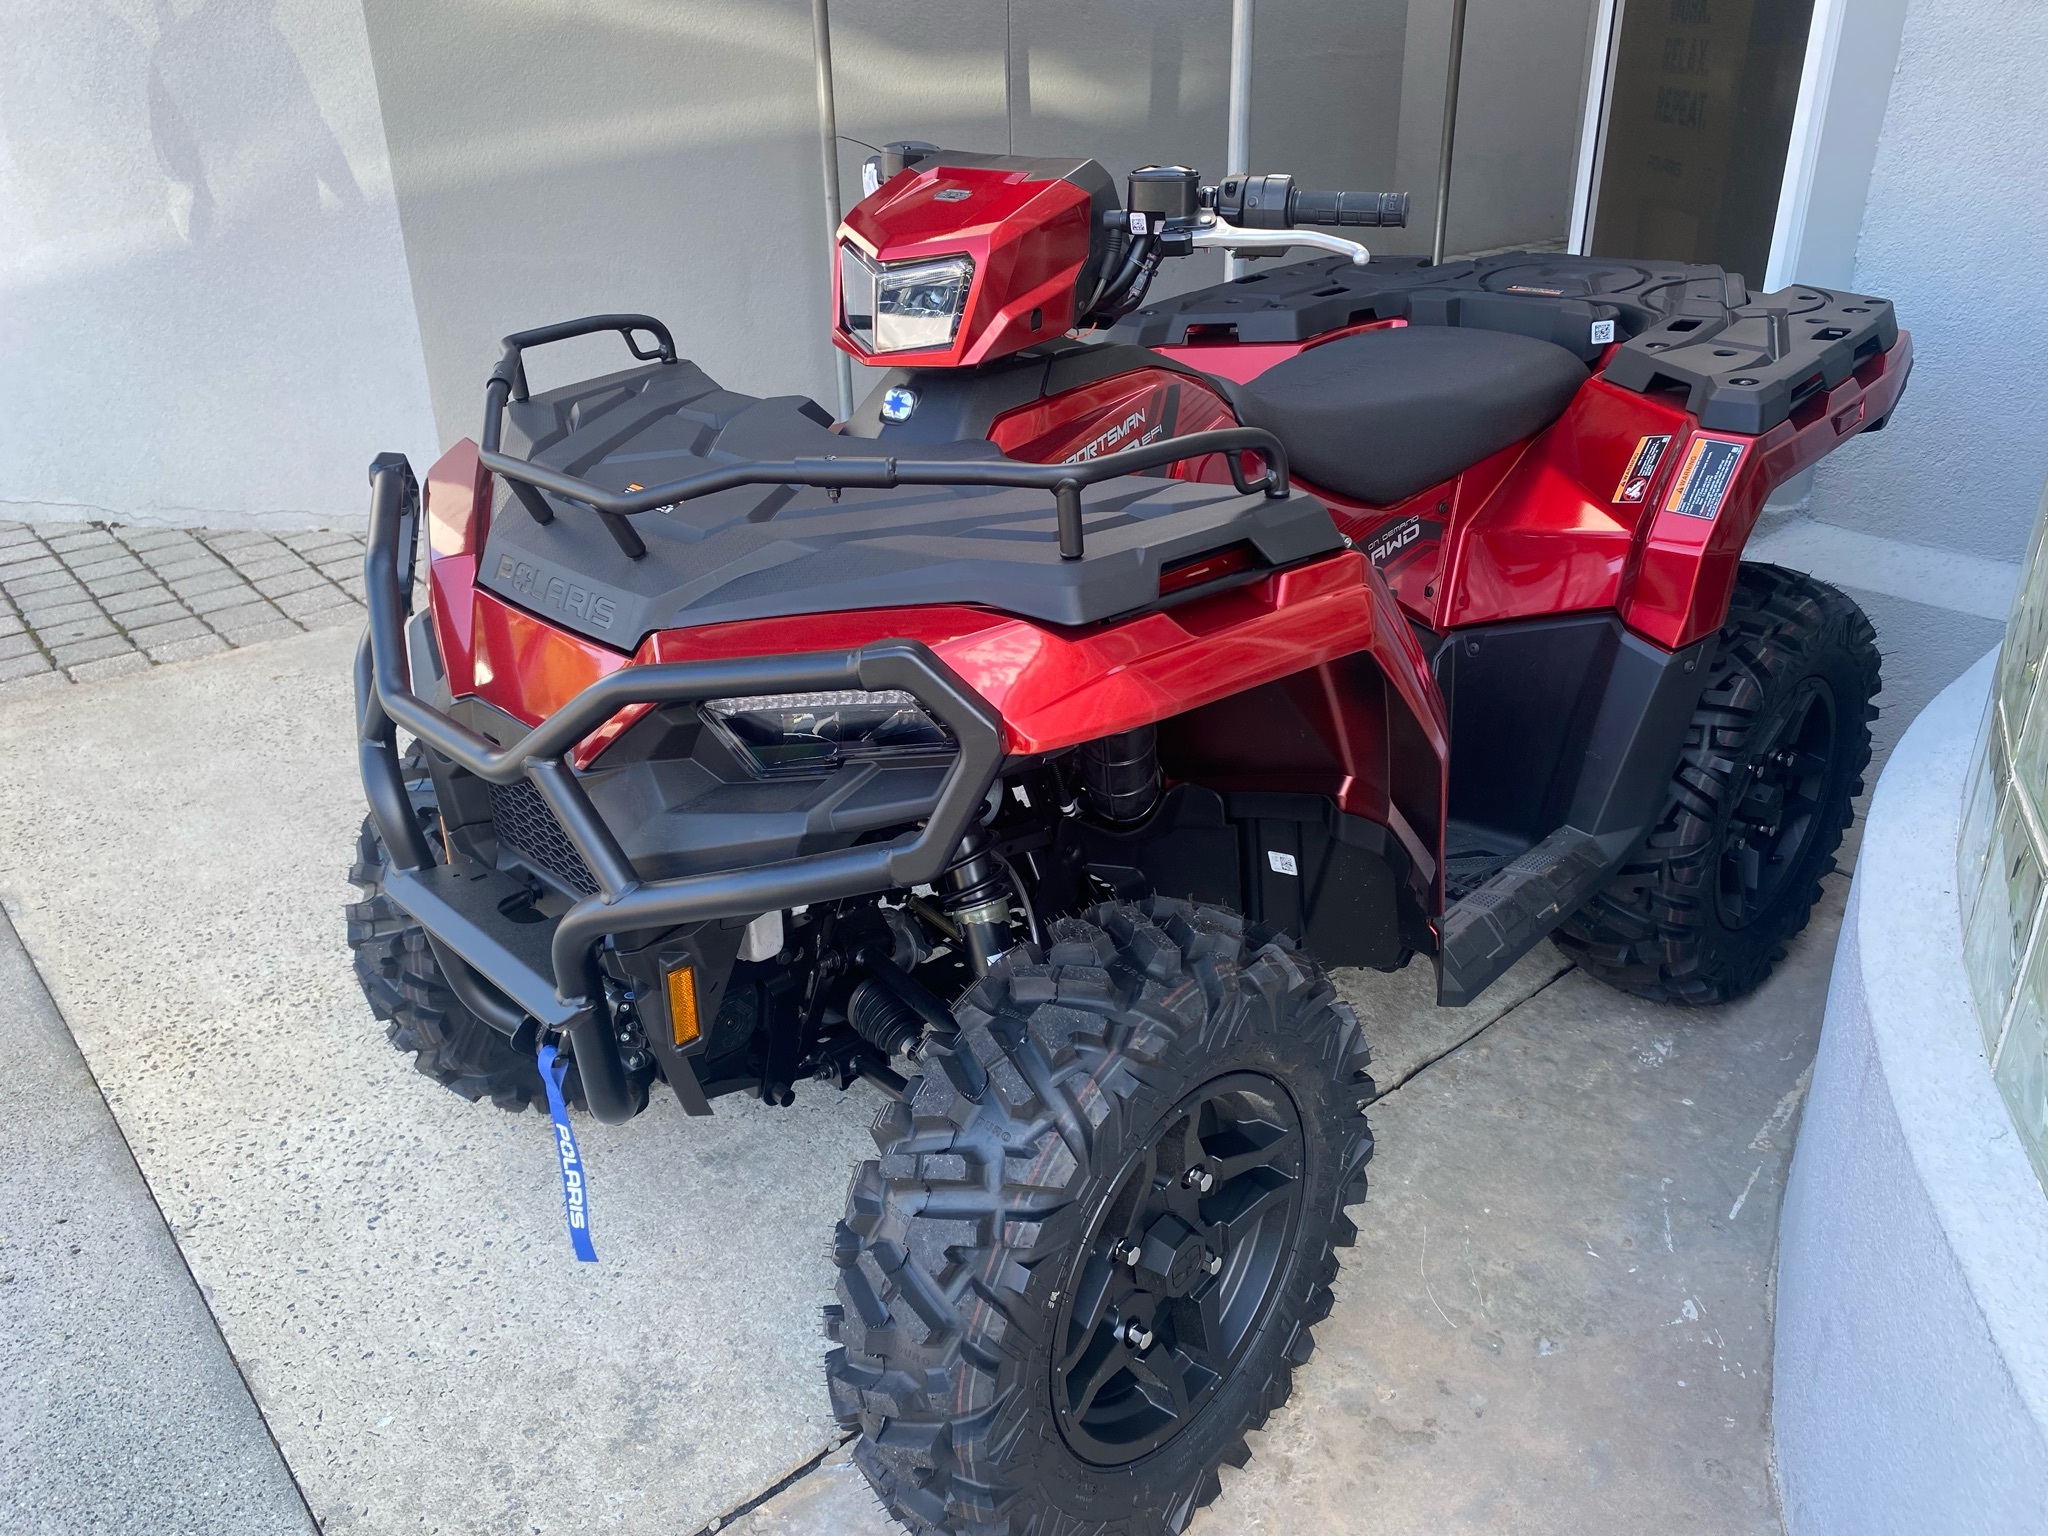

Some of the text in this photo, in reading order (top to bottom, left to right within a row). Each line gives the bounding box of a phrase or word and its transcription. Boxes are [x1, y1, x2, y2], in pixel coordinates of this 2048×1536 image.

[1061, 407, 1146, 464] PORTSMAN
[1141, 424, 1163, 446] EFI
[1623, 452, 1640, 480] WARNING
[1679, 455, 1698, 488] WARNING
[1370, 523, 1421, 567] AWD
[494, 552, 618, 631] POLARIS
[975, 1116, 1012, 1142] DURO
[555, 1122, 586, 1230] POLARIS
